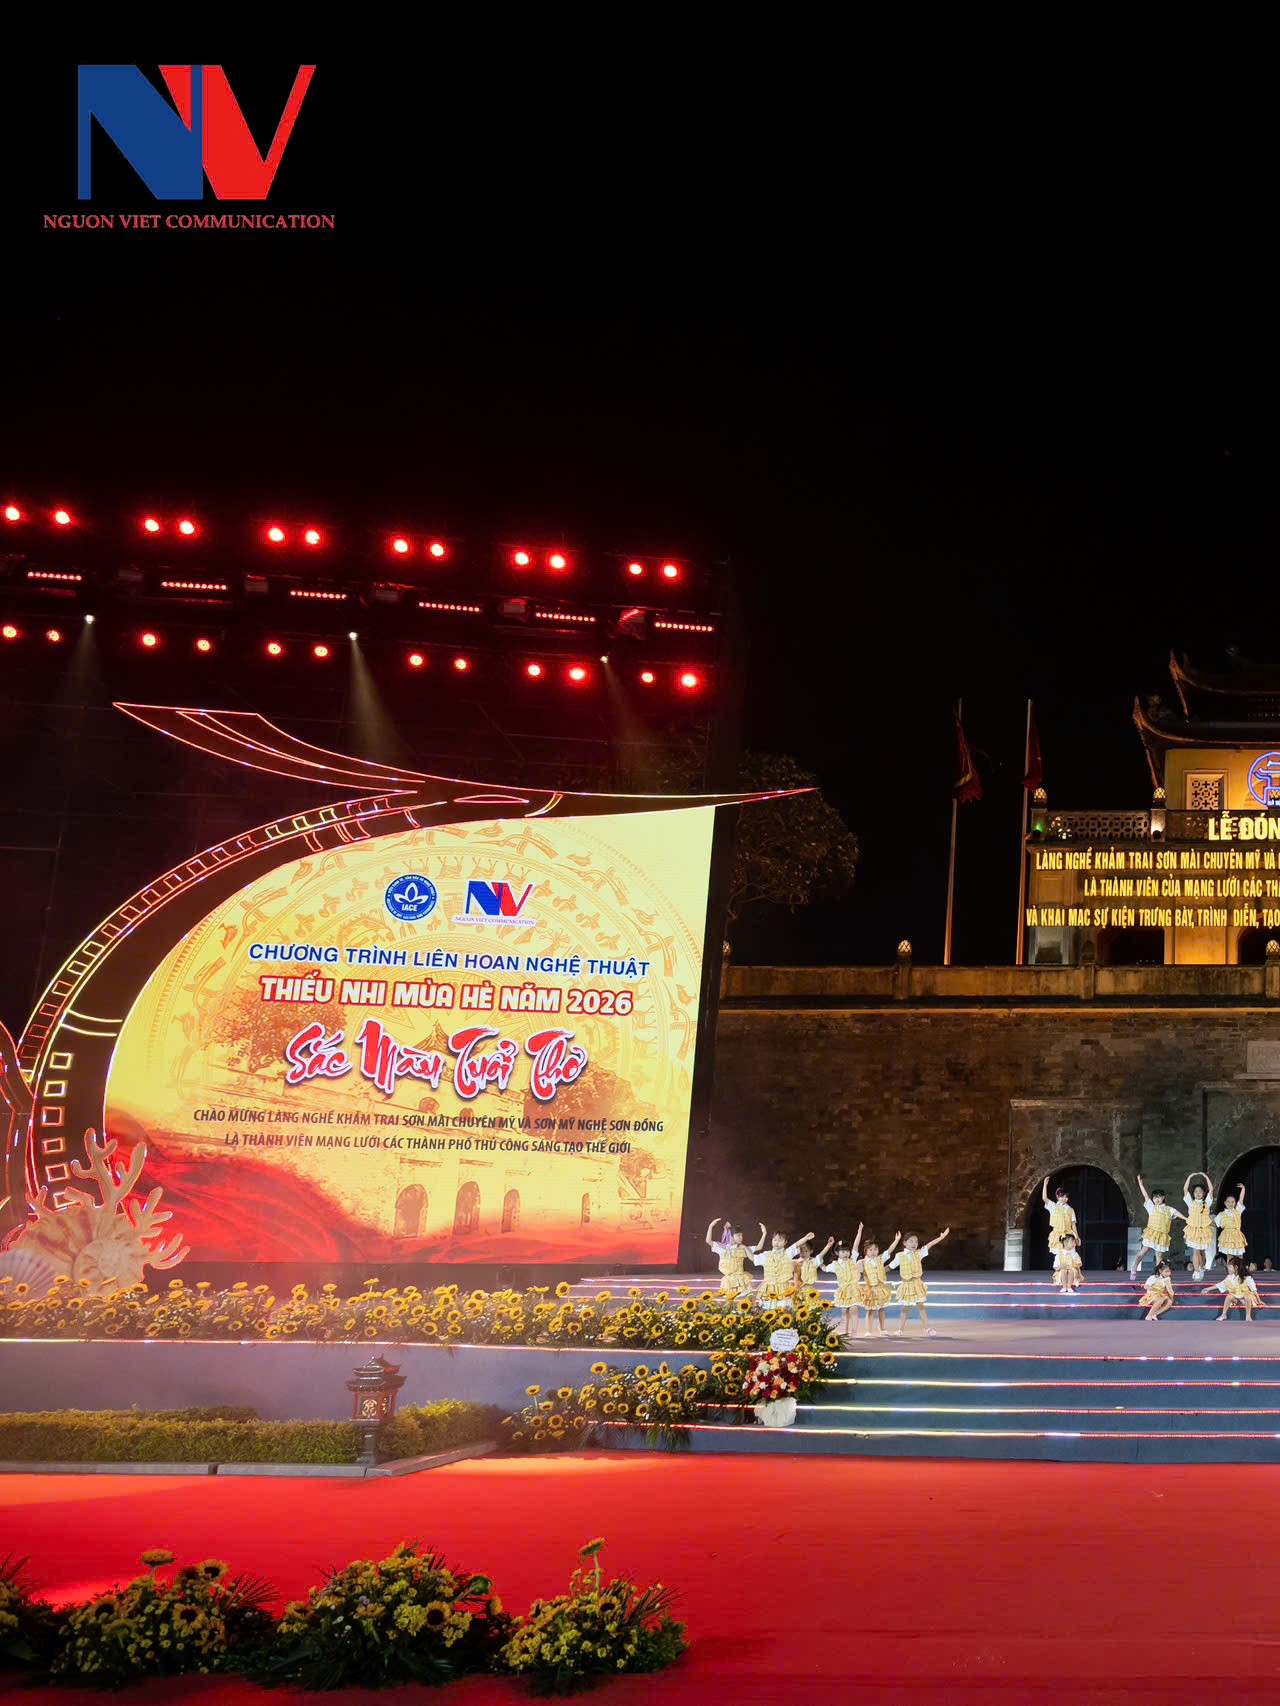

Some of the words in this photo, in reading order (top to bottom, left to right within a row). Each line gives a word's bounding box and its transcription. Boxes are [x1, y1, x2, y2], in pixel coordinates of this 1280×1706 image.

[1208, 810, 1233, 841] LỄ
[1036, 850, 1063, 870] LÀNG
[1095, 846, 1125, 870] KHẢM
[1129, 851, 1153, 870] TRAI
[1156, 851, 1177, 870] SƠN
[1180, 850, 1200, 870] MÀI
[1203, 848, 1243, 870] CHUYÊN
[1245, 848, 1262, 870] MỸ
[1264, 848, 1276, 870] VÀ
[465, 880, 533, 916] NV
[1084, 877, 1097, 897] LÀ
[1100, 877, 1134, 897] THÀNH
[1136, 878, 1159, 897] VIÊN
[1161, 873, 1181, 897] CỦA
[1184, 879, 1214, 900] MẠNG
[1217, 876, 1240, 897] LƯỚI
[1243, 876, 1263, 897] CÁC
[401, 903, 418, 912] IACE
[1026, 905, 1038, 927] VÀ
[1041, 908, 1065, 927] KHAI
[1093, 907, 1109, 929] SỰ
[1111, 905, 1135, 929] KIỆN
[1139, 907, 1172, 927] TRƯNG
[1197, 905, 1227, 927] TRÌNH
[1262, 908, 1280, 931] TẠO
[249, 943, 339, 963] CHƯƠNG
[345, 945, 407, 966] TRÌNH
[413, 949, 458, 968] LIÊN
[464, 954, 520, 971] HOAN
[525, 955, 581, 977] NGHỆ
[587, 958, 650, 979] THUẬT
[259, 969, 335, 1003] THIẾU
[339, 979, 388, 1005] NHI
[392, 978, 455, 1008] MÙA
[460, 981, 495, 1010] HÈ
[499, 982, 562, 1013] NĂM
[566, 989, 633, 1015] 2026
[193, 1109, 225, 1122] CHÀO
[227, 1109, 265, 1123] MỪNG
[267, 1109, 299, 1123] LÀNG
[336, 1110, 371, 1125] KHẢM
[374, 1114, 399, 1126] TRAI
[402, 1114, 426, 1126] SƠN
[427, 1113, 449, 1127] MÀI
[452, 1115, 496, 1128] CHUYÊN
[498, 1116, 515, 1129] MỸ
[517, 1116, 531, 1129] VÀ
[534, 1117, 556, 1129] SƠN
[558, 1118, 576, 1130] MỸ
[577, 1118, 607, 1134] NGHỆ
[609, 1119, 631, 1131] SƠN
[224, 1131, 239, 1146] LÀ
[242, 1132, 283, 1146] THÀNH
[286, 1134, 313, 1147] VIÊN
[315, 1135, 351, 1150] MẠNG
[353, 1136, 380, 1148] LƯỚI
[383, 1136, 403, 1149] CÁC
[406, 1136, 445, 1150] THÀNH
[448, 1135, 473, 1150] PHỐ
[474, 1136, 497, 1151] THỦ
[499, 1138, 529, 1152] CÔNG
[531, 1139, 561, 1152] SÁNG
[563, 1141, 583, 1156] TẠO
[586, 1138, 607, 1153] THẾ
[608, 1139, 631, 1154] GIỚI
